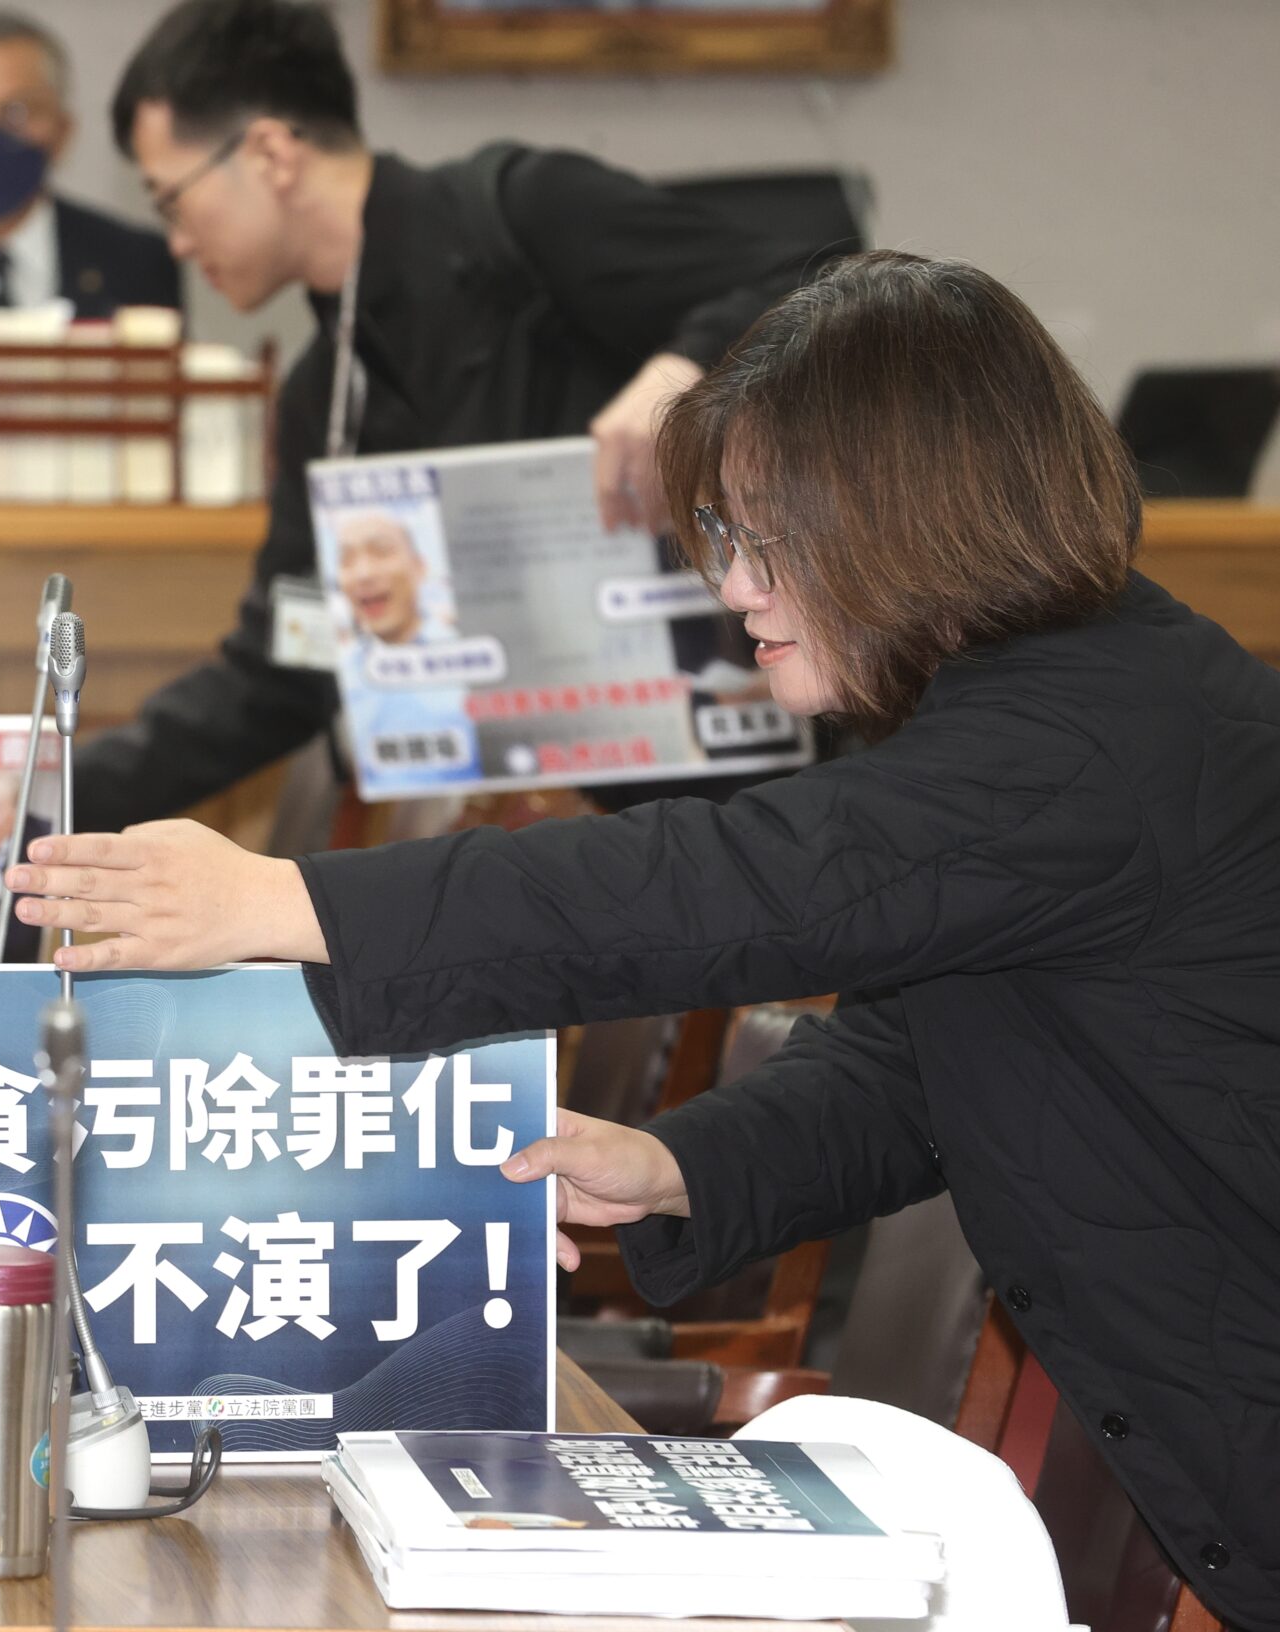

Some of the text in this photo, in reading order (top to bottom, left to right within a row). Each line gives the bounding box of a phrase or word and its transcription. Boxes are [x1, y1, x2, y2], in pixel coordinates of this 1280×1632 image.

[82, 1211, 515, 1345] 不演了!
[226, 1398, 316, 1417] 立法院黨團
[547, 1437, 701, 1530] 助理費成小金庫
